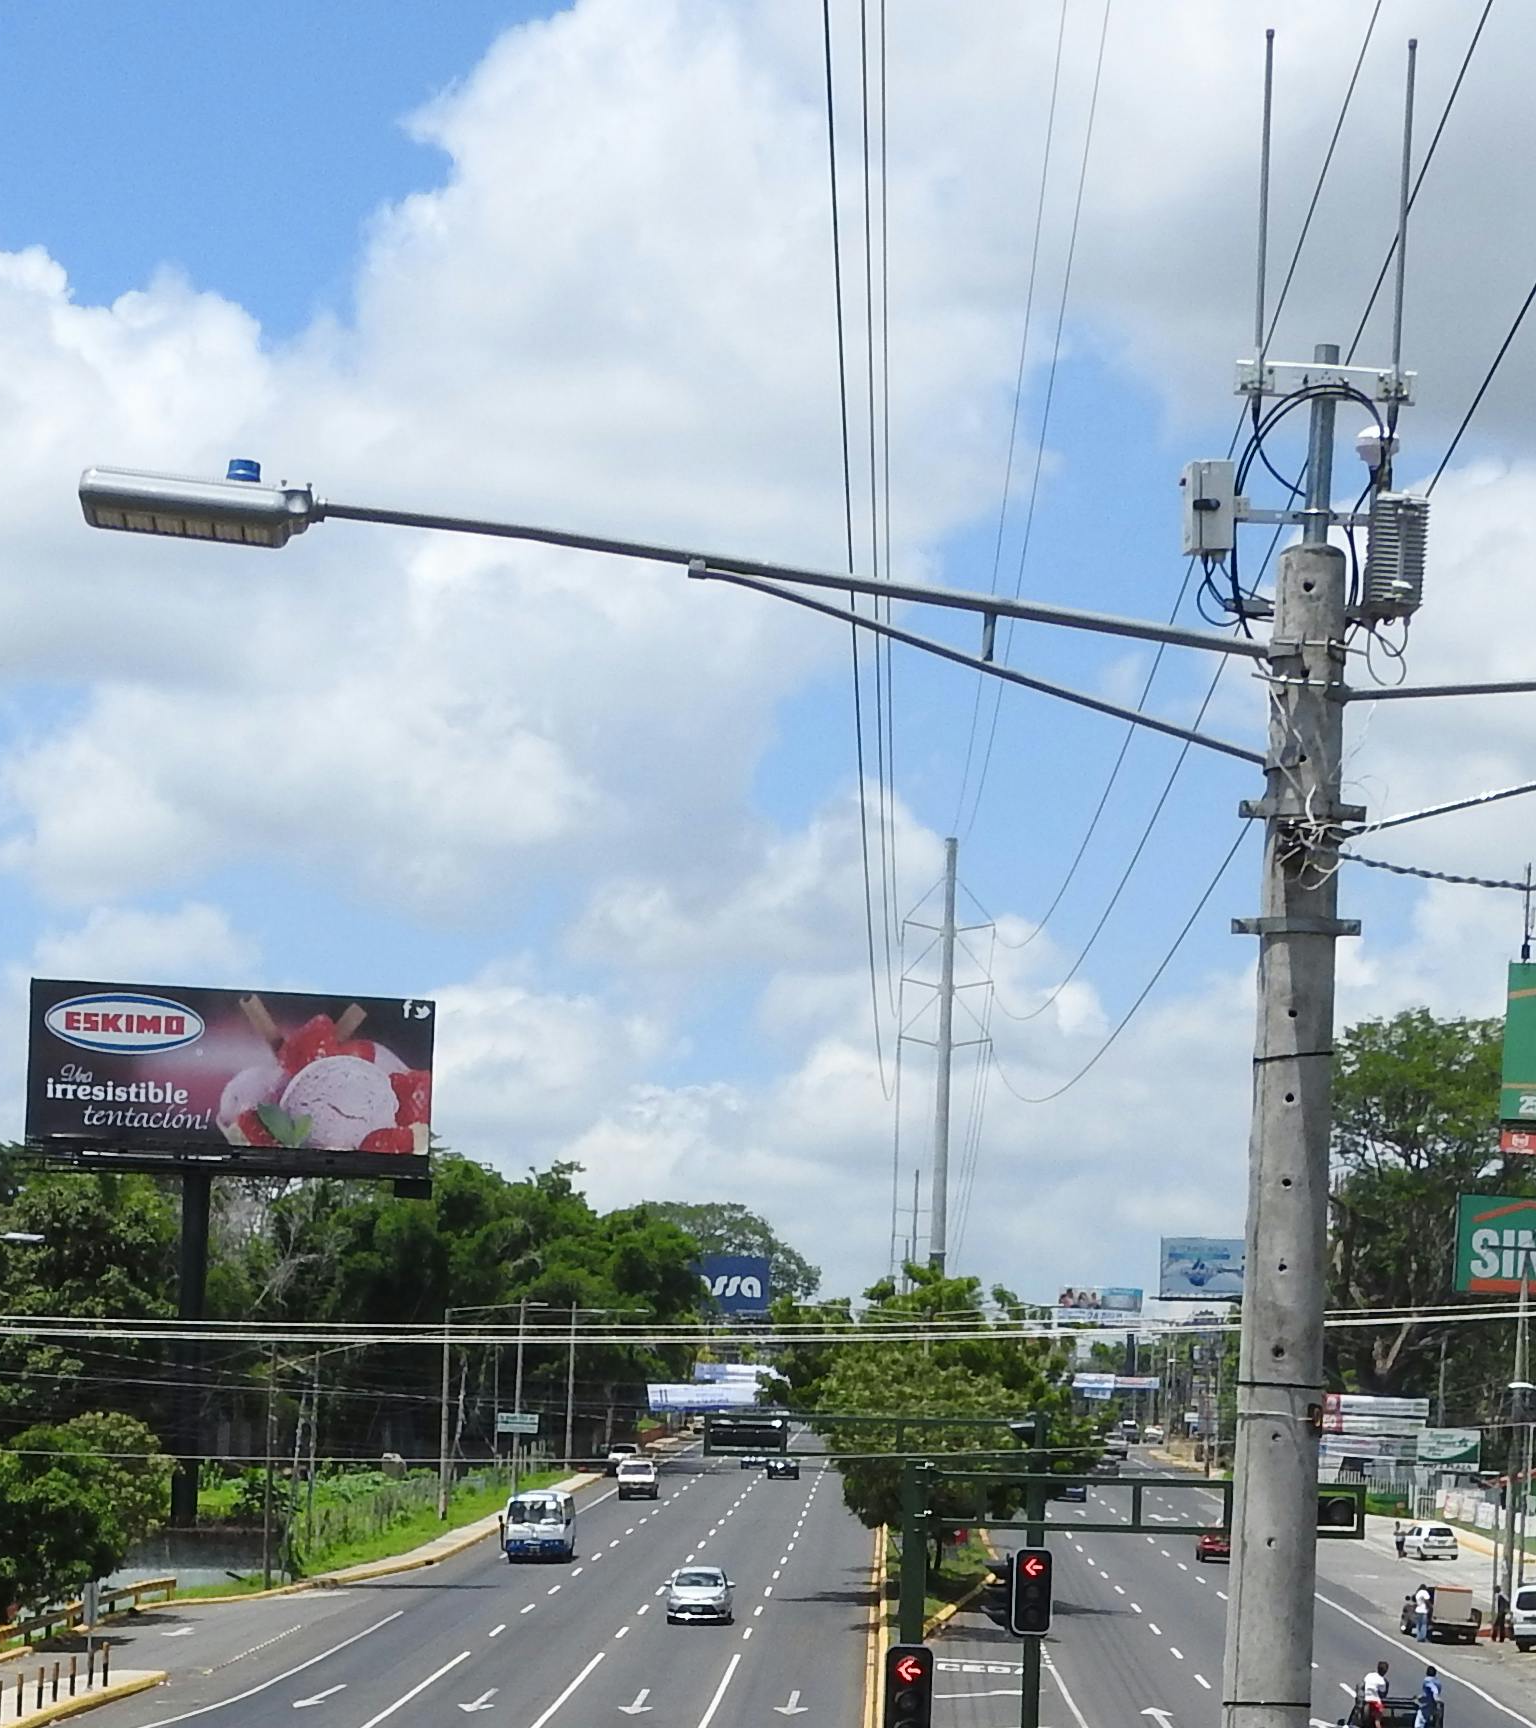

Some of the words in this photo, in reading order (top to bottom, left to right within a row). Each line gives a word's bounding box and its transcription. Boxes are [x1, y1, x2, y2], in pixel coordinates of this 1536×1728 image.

[64, 1011, 186, 1037] ESKIMO
[60, 1063, 94, 1084] Una
[46, 1077, 189, 1105] irresistible
[83, 1104, 212, 1130] tentación!
